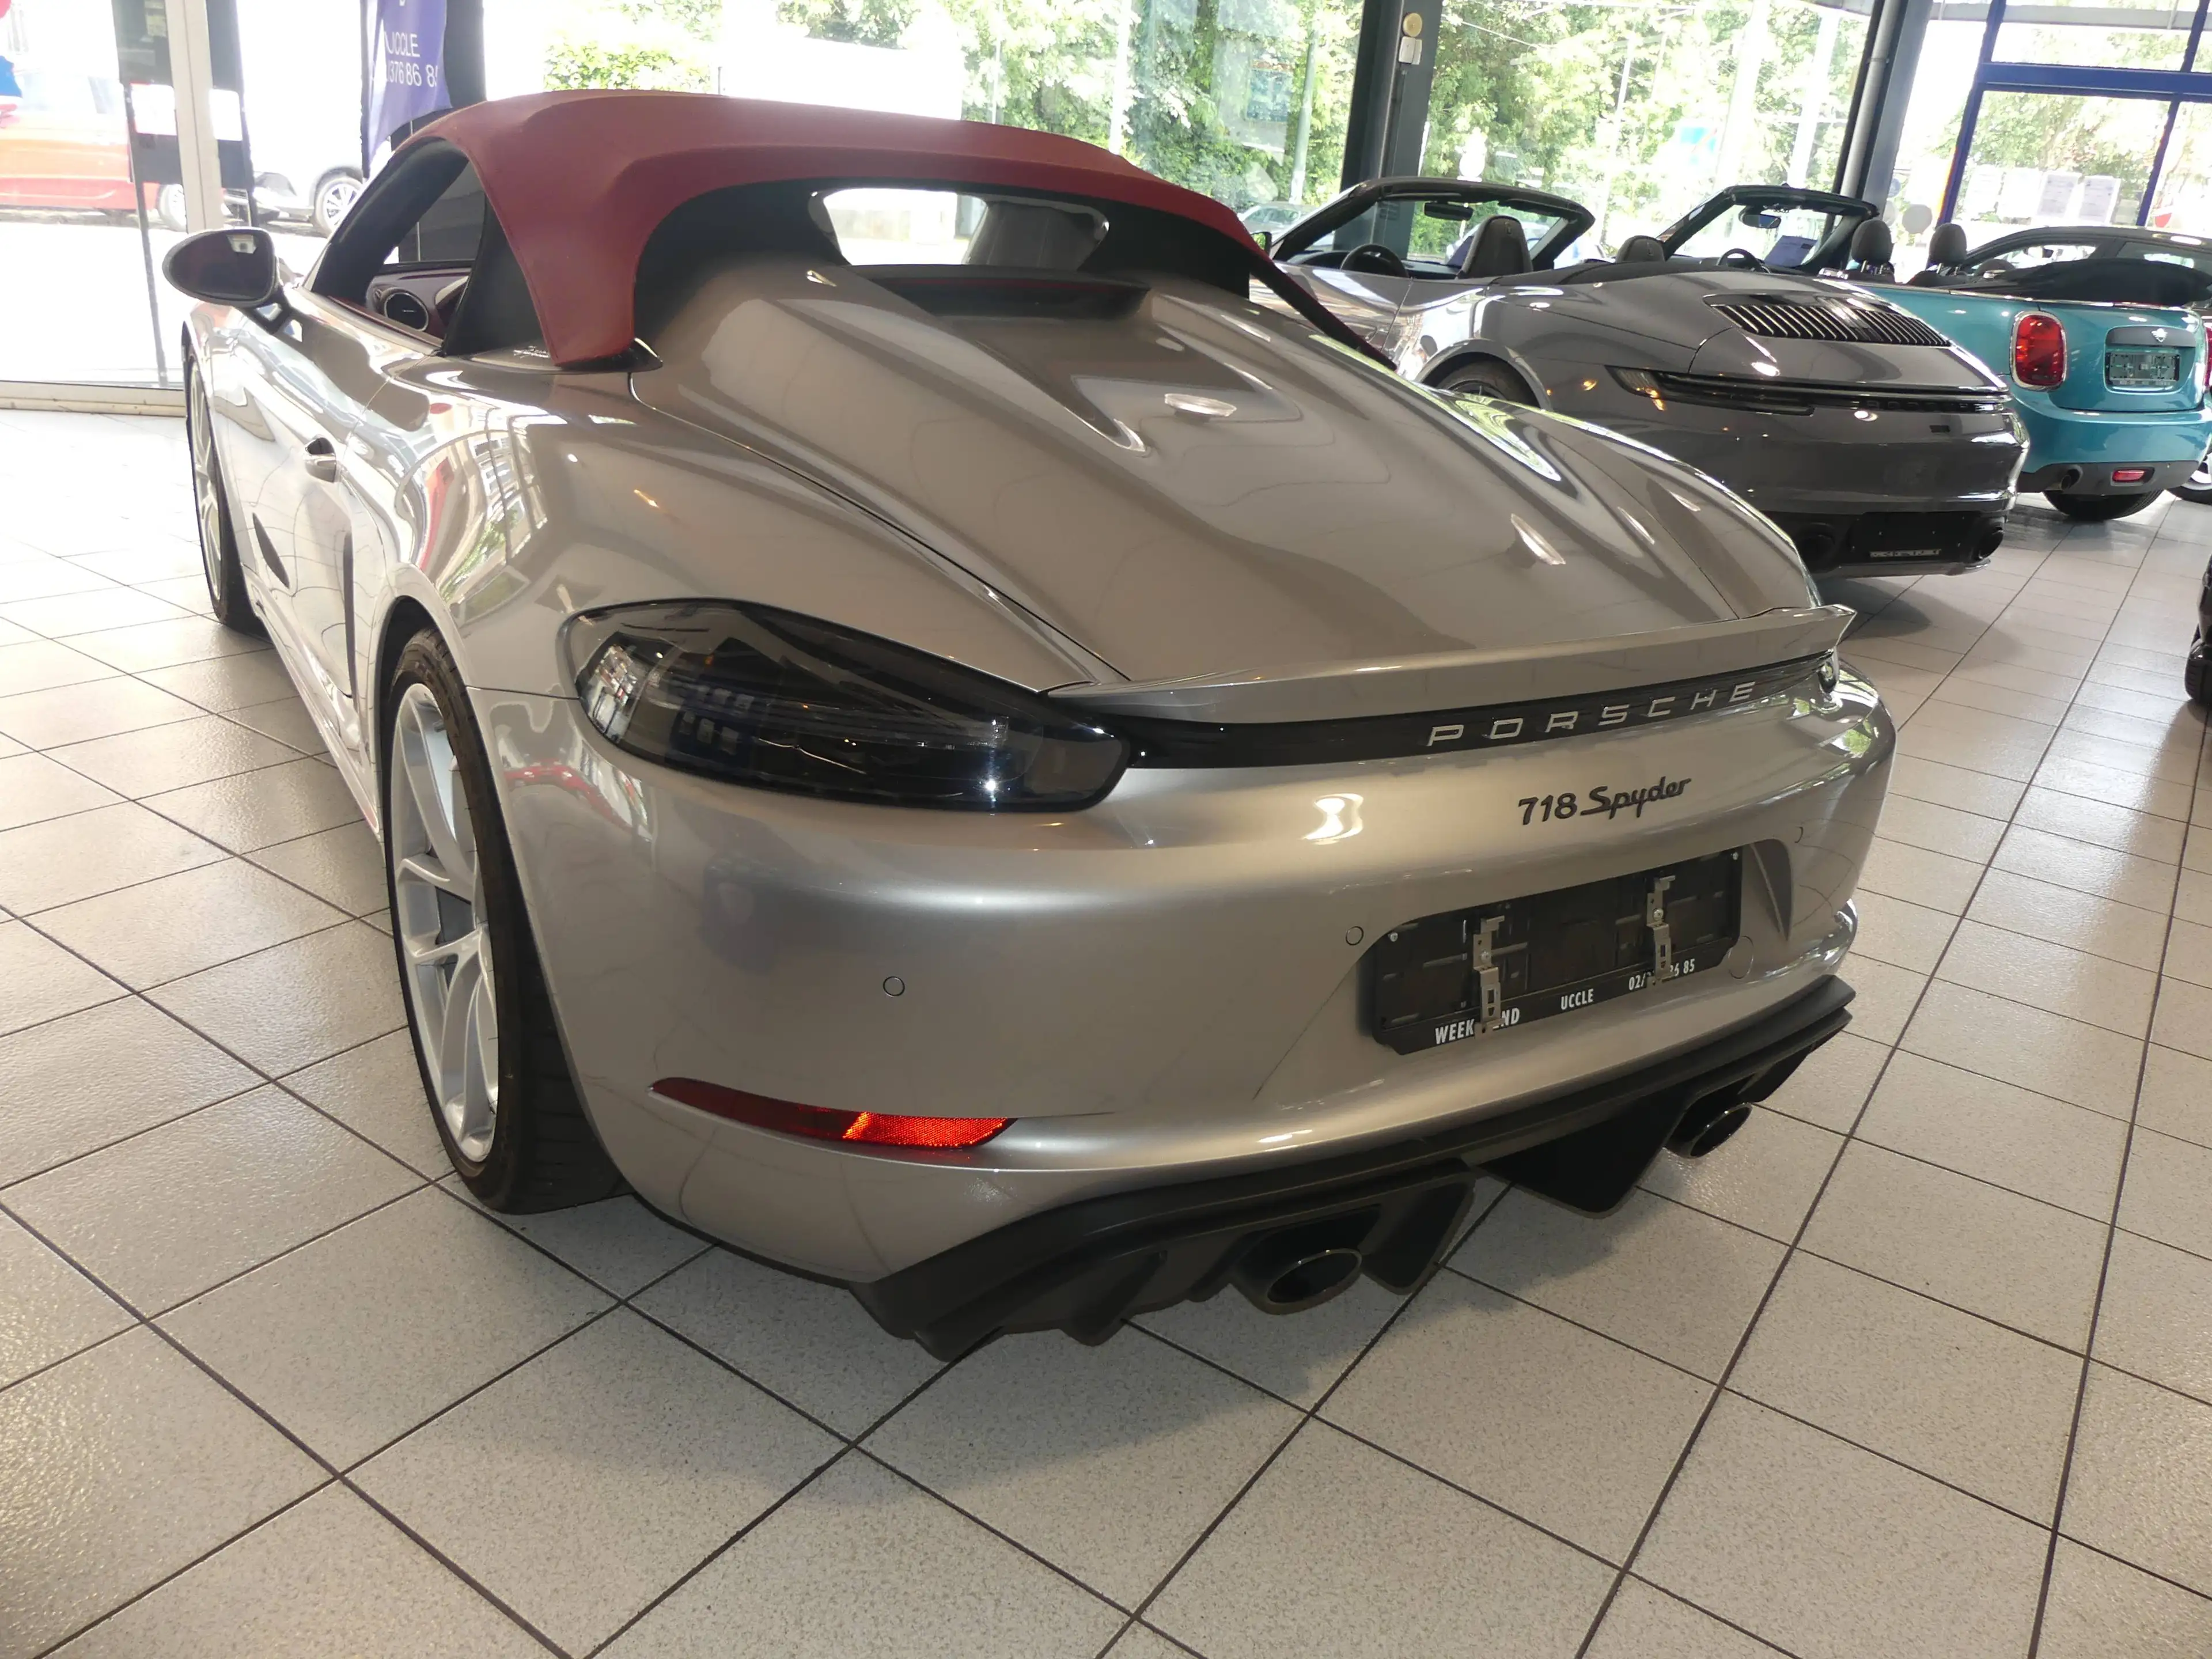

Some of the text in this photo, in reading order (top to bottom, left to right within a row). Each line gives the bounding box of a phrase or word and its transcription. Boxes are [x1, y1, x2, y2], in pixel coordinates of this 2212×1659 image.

[406, 62, 422, 86] 86
[1426, 681, 1756, 747] PORSCHE
[1518, 776, 1692, 825] 718 Spyder
[1493, 1007, 1520, 1031] ND
[1560, 988, 1594, 1010] UCCLE
[1683, 959, 1695, 974] 85
